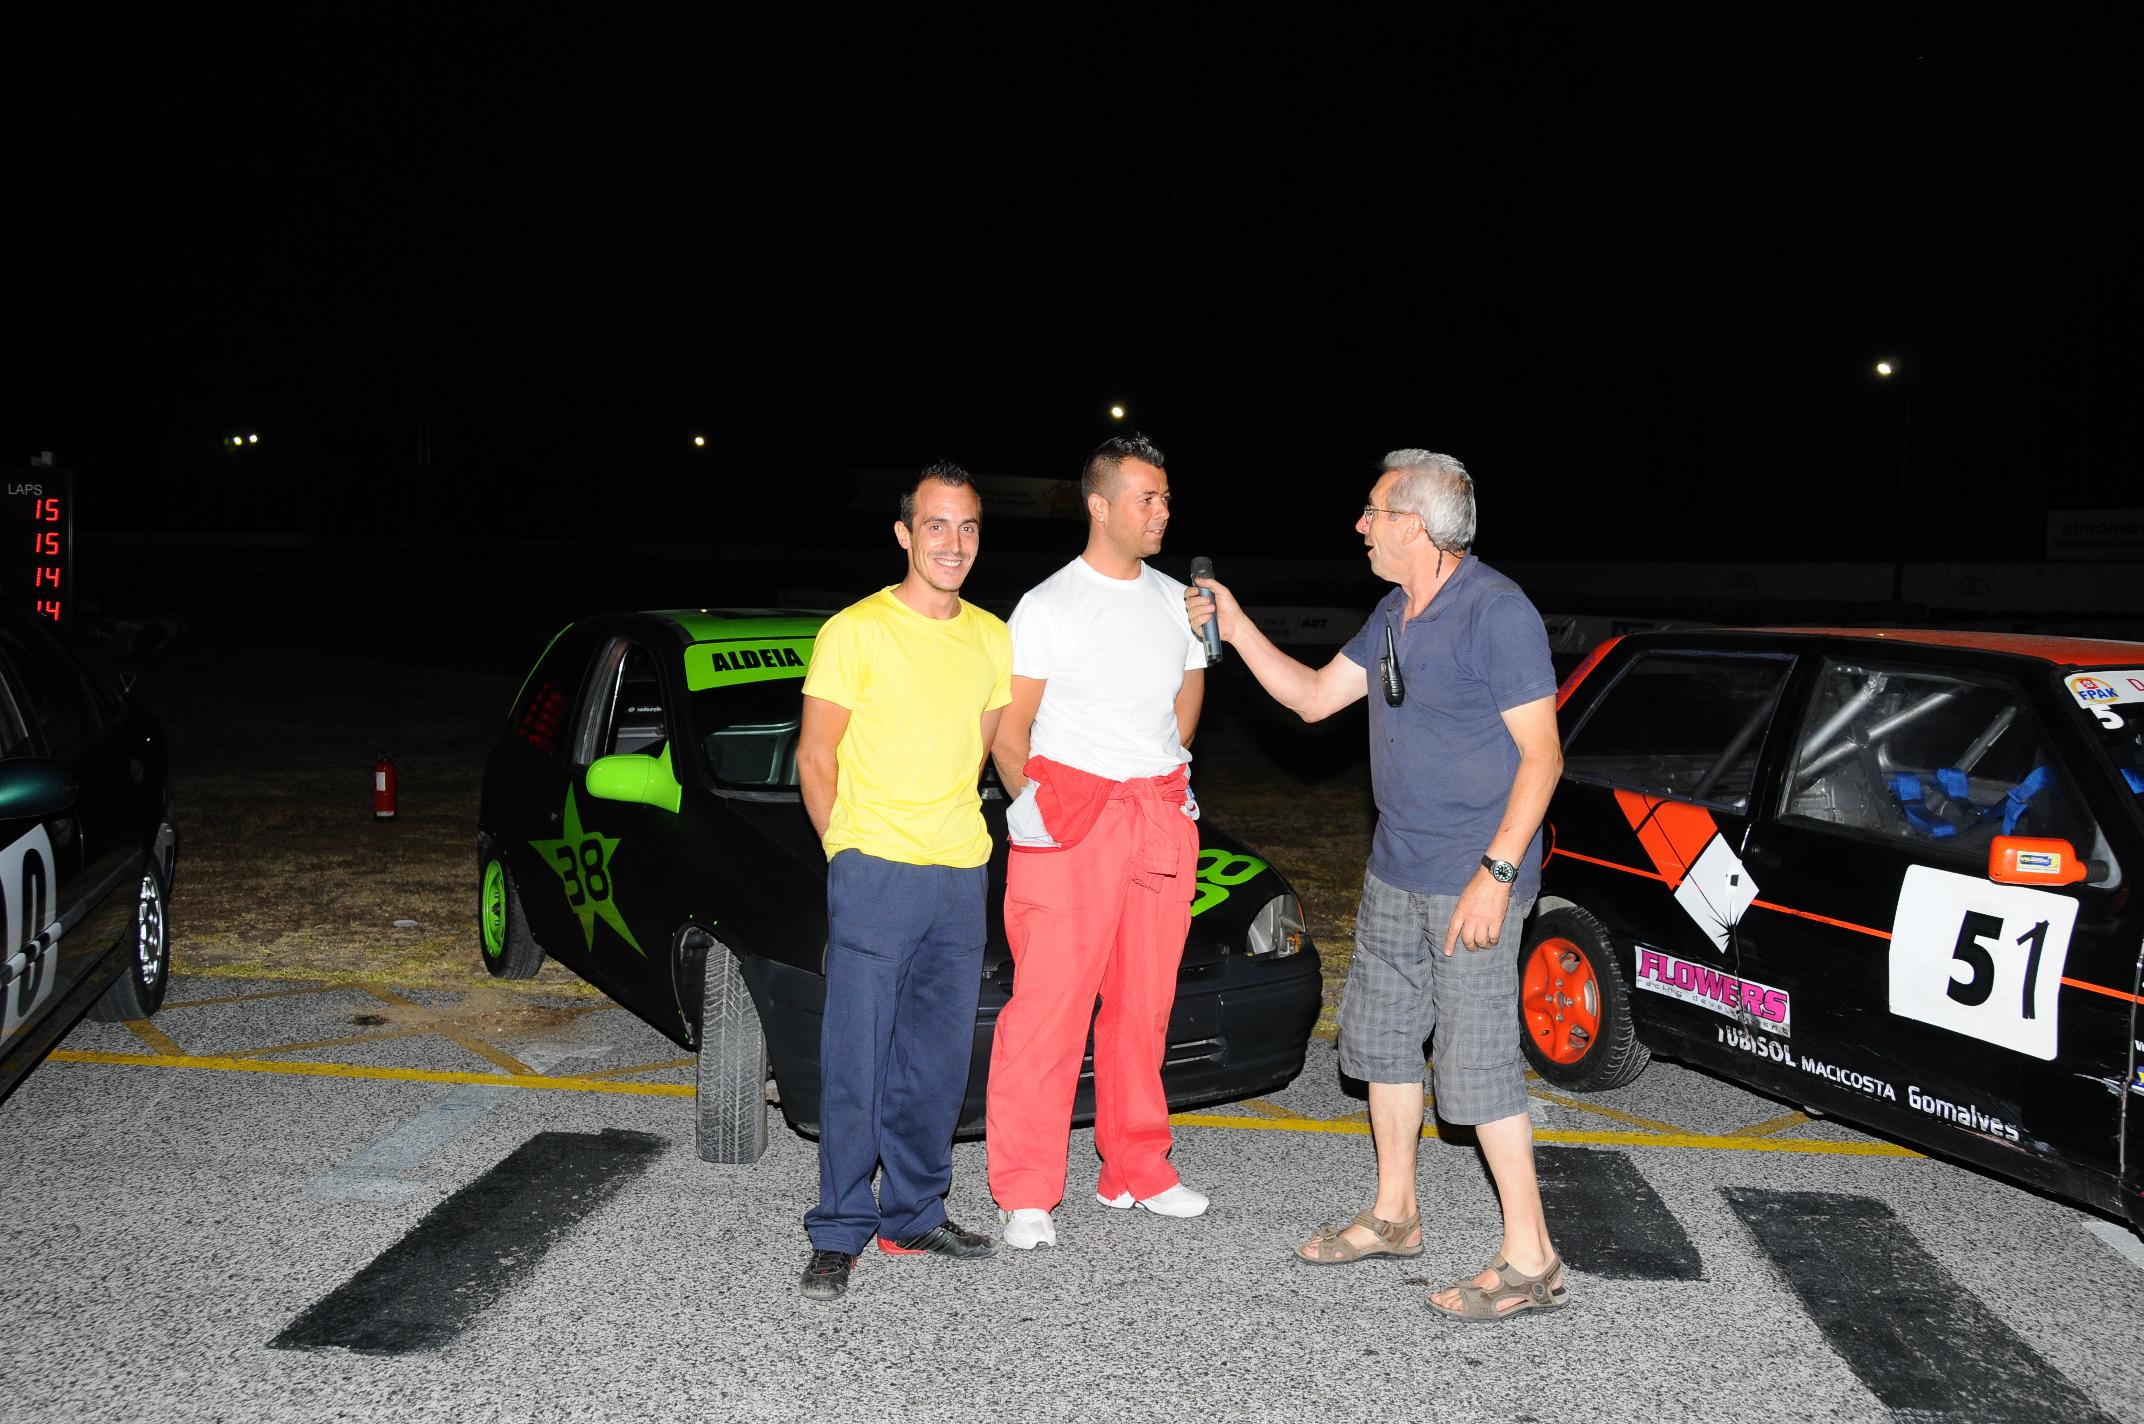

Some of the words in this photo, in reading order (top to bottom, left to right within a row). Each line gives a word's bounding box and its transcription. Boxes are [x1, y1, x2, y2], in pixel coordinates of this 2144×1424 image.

[7, 482, 44, 497] LAPS
[34, 498, 61, 522] 15
[34, 532, 61, 556] 15
[34, 567, 62, 588] 14
[711, 647, 805, 672] ALDEIA
[2078, 688, 2119, 701] FPAK
[555, 838, 609, 907] 38
[1946, 909, 2050, 1020] 51
[1639, 949, 1788, 1024] FLOWERS
[1801, 1055, 1897, 1102] MACICOSTA
